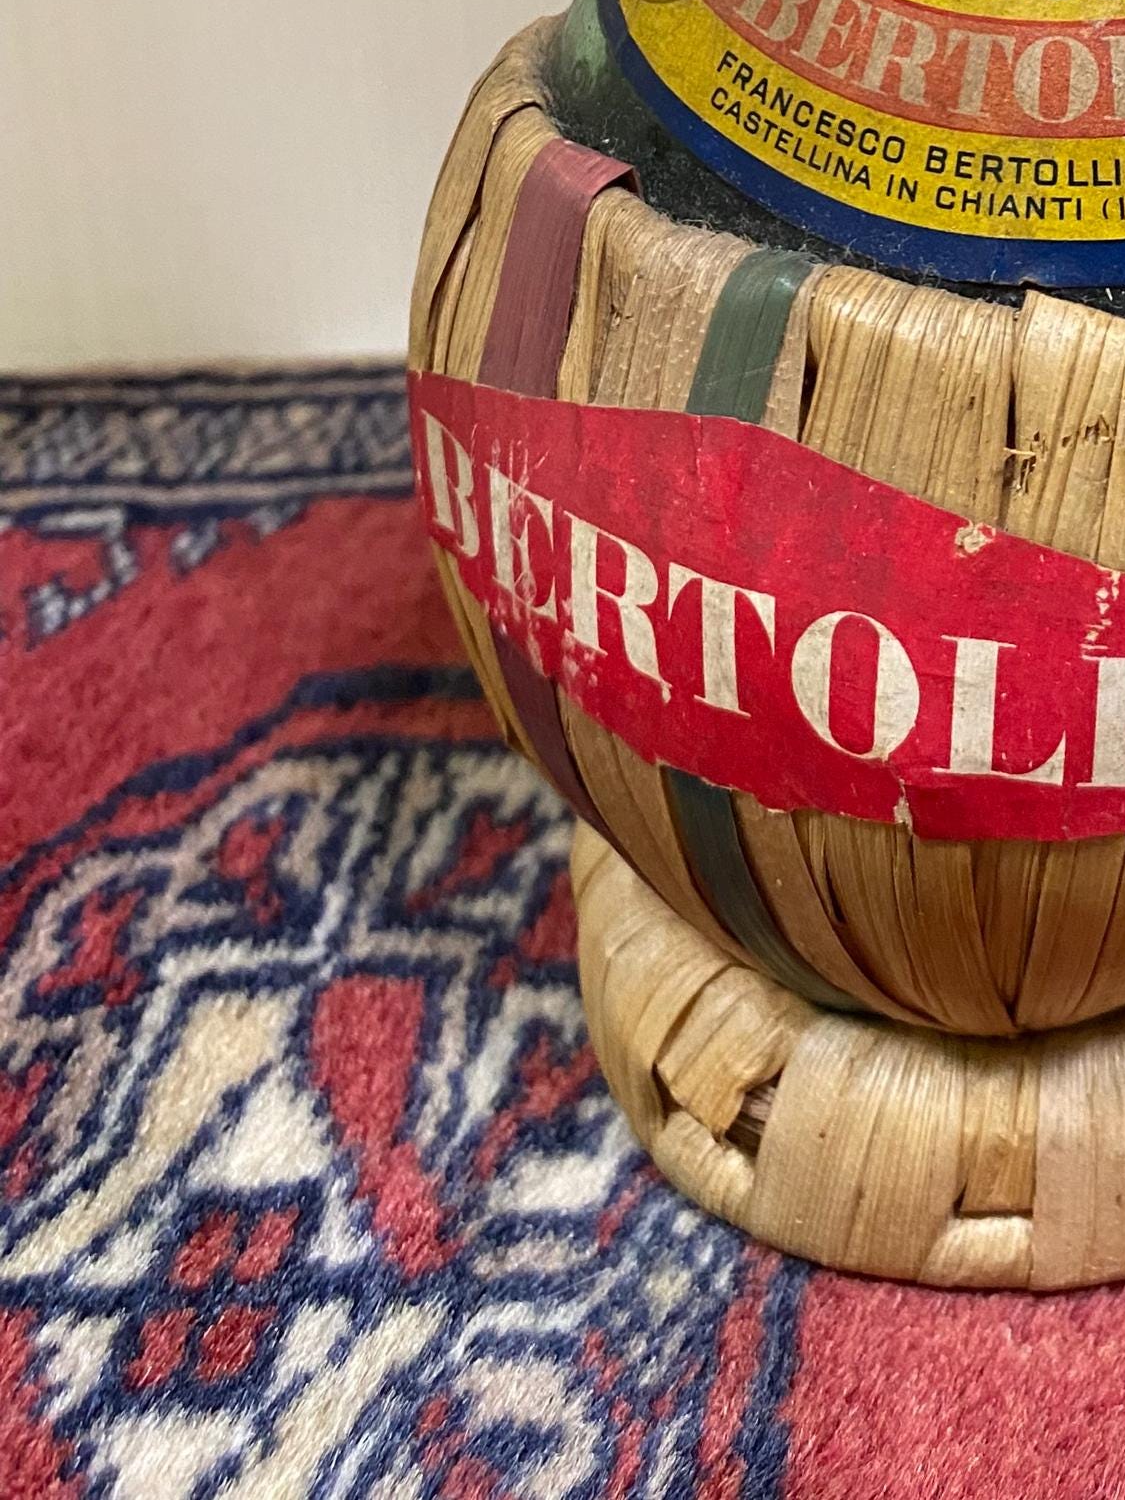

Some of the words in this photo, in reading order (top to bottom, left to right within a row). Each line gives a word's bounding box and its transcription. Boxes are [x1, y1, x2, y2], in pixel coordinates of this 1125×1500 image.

[710, 87, 871, 191] CASTELLINA
[886, 174, 918, 203] IN
[935, 185, 1082, 221] CHIANTI
[716, 50, 906, 164] FRANCESCO
[925, 145, 1121, 187] BERTOLLI
